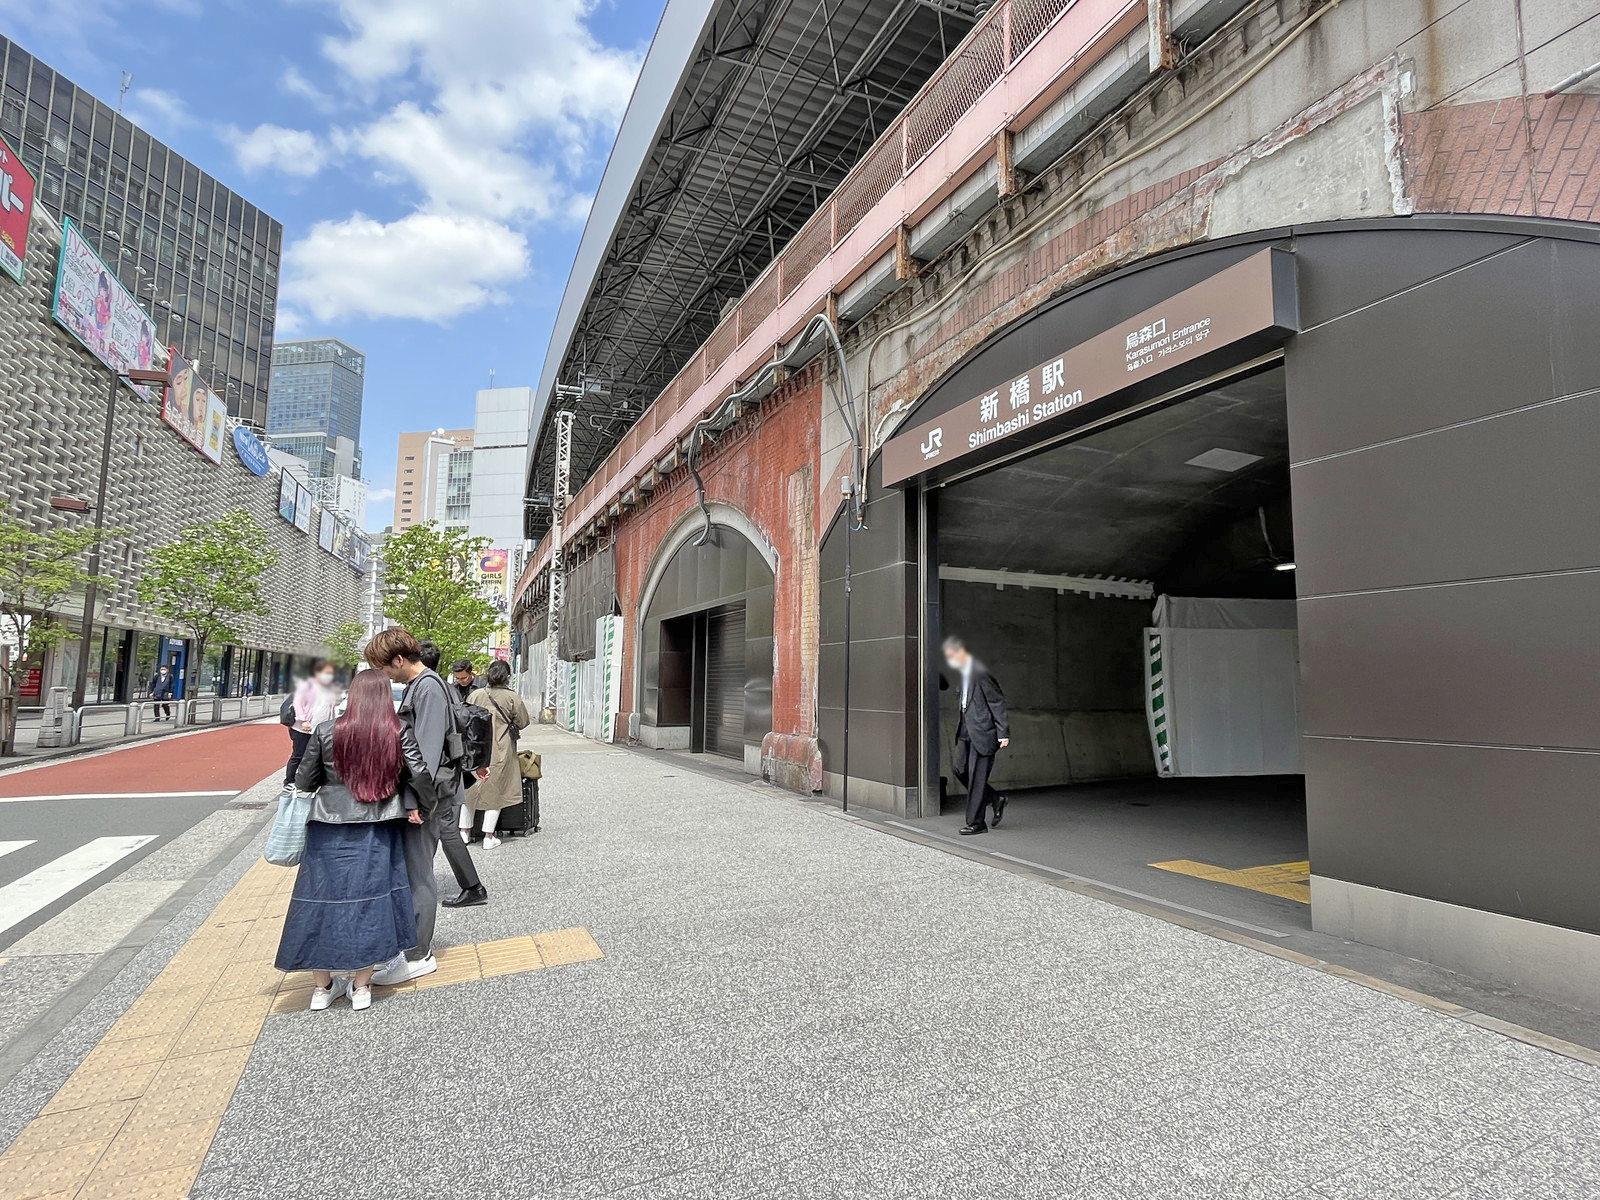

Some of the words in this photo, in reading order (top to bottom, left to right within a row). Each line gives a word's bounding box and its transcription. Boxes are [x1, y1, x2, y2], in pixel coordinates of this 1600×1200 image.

[1125, 318, 1166, 350] 烏森口
[1126, 333, 1170, 362] Karasumori
[1172, 317, 1211, 341] Entrance
[980, 358, 1065, 423] 新橋駅
[920, 427, 943, 454] JR
[968, 409, 1030, 449] Shimbashi
[1033, 389, 1083, 421] Station
